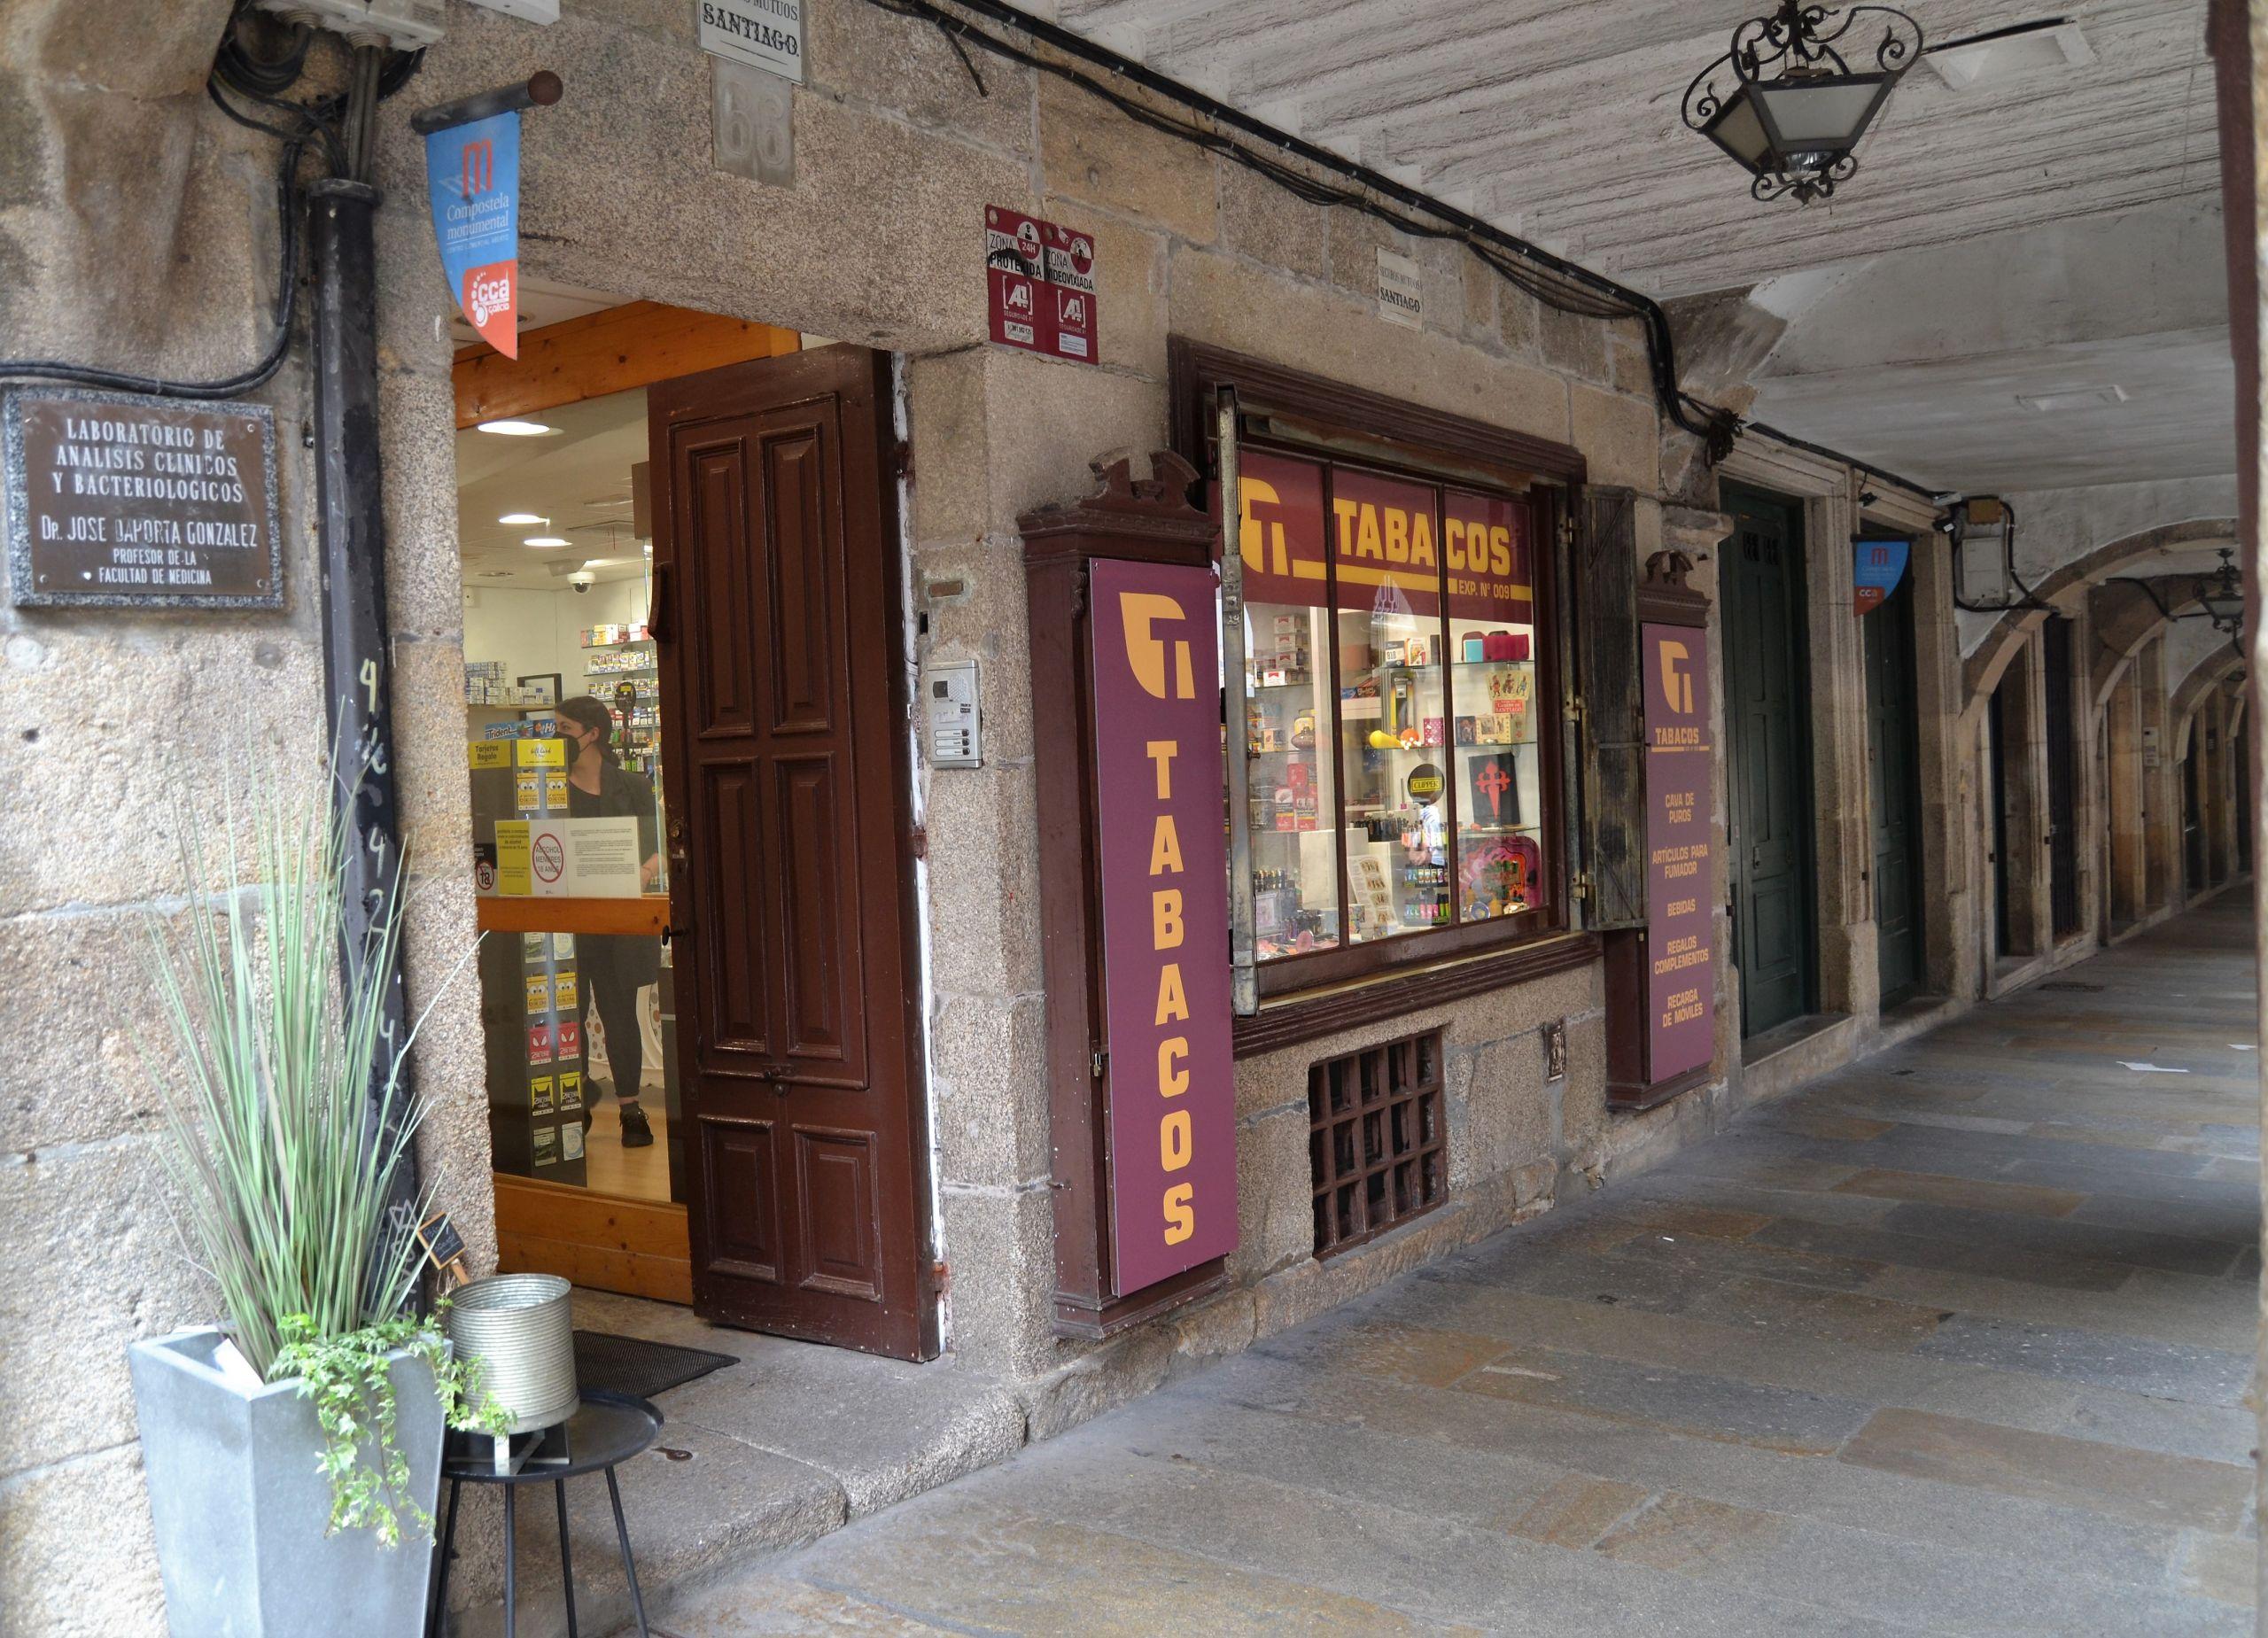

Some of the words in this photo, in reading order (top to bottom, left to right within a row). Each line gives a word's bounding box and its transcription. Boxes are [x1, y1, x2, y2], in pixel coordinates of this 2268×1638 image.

[447, 192, 509, 221] Compostela
[447, 210, 509, 240] monumental
[990, 233, 1014, 250] ZONA
[1021, 241, 1037, 254] 24H
[990, 252, 1042, 278] PROTEIDA
[1045, 250, 1068, 268] ZONA
[1046, 267, 1094, 291] VIDEOVIXIADA
[1380, 286, 1421, 313] SANTIAGO
[66, 418, 195, 448] LABORATORIO
[204, 429, 224, 450] DE
[57, 445, 144, 470] ANALISIS
[154, 451, 237, 477] CLINICOS
[52, 472, 63, 493] Y
[74, 474, 243, 503] BACTERIOLOGICOS
[67, 516, 107, 542] JOSE
[115, 519, 181, 545] DAPORTA
[186, 521, 257, 547] GONZALEZ
[1332, 497, 1511, 576] TABACOS
[113, 547, 164, 564] PROFESOR
[167, 549, 181, 565] DE
[184, 550, 197, 566] LA
[98, 568, 148, 584] FACULTAD
[152, 569, 165, 585] DE
[169, 570, 212, 585] MEDICINA
[1458, 579, 1478, 596] EXP.
[1493, 584, 1510, 600] 009
[487, 724, 512, 740] Trident
[1655, 726, 1699, 745] TABACOS
[1413, 780, 1440, 789] CLIPPER
[1666, 794, 1683, 809] CAVA
[1685, 792, 1695, 806] DE
[1668, 809, 1692, 824] PUROS
[1652, 846, 1689, 865] ARTÍCULOS
[1691, 843, 1708, 858] PARA
[480, 871, 491, 885] 18
[1665, 861, 1697, 879] FUMADOR
[1667, 898, 1696, 918] BEBIDAS
[1667, 935, 1697, 956] REGALOS
[1654, 948, 1709, 975] COMPLEMENTOS
[1146, 741, 1194, 1246] TABACOS
[1667, 988, 1698, 1010] RECARGA
[1662, 1013, 1673, 1028] DE
